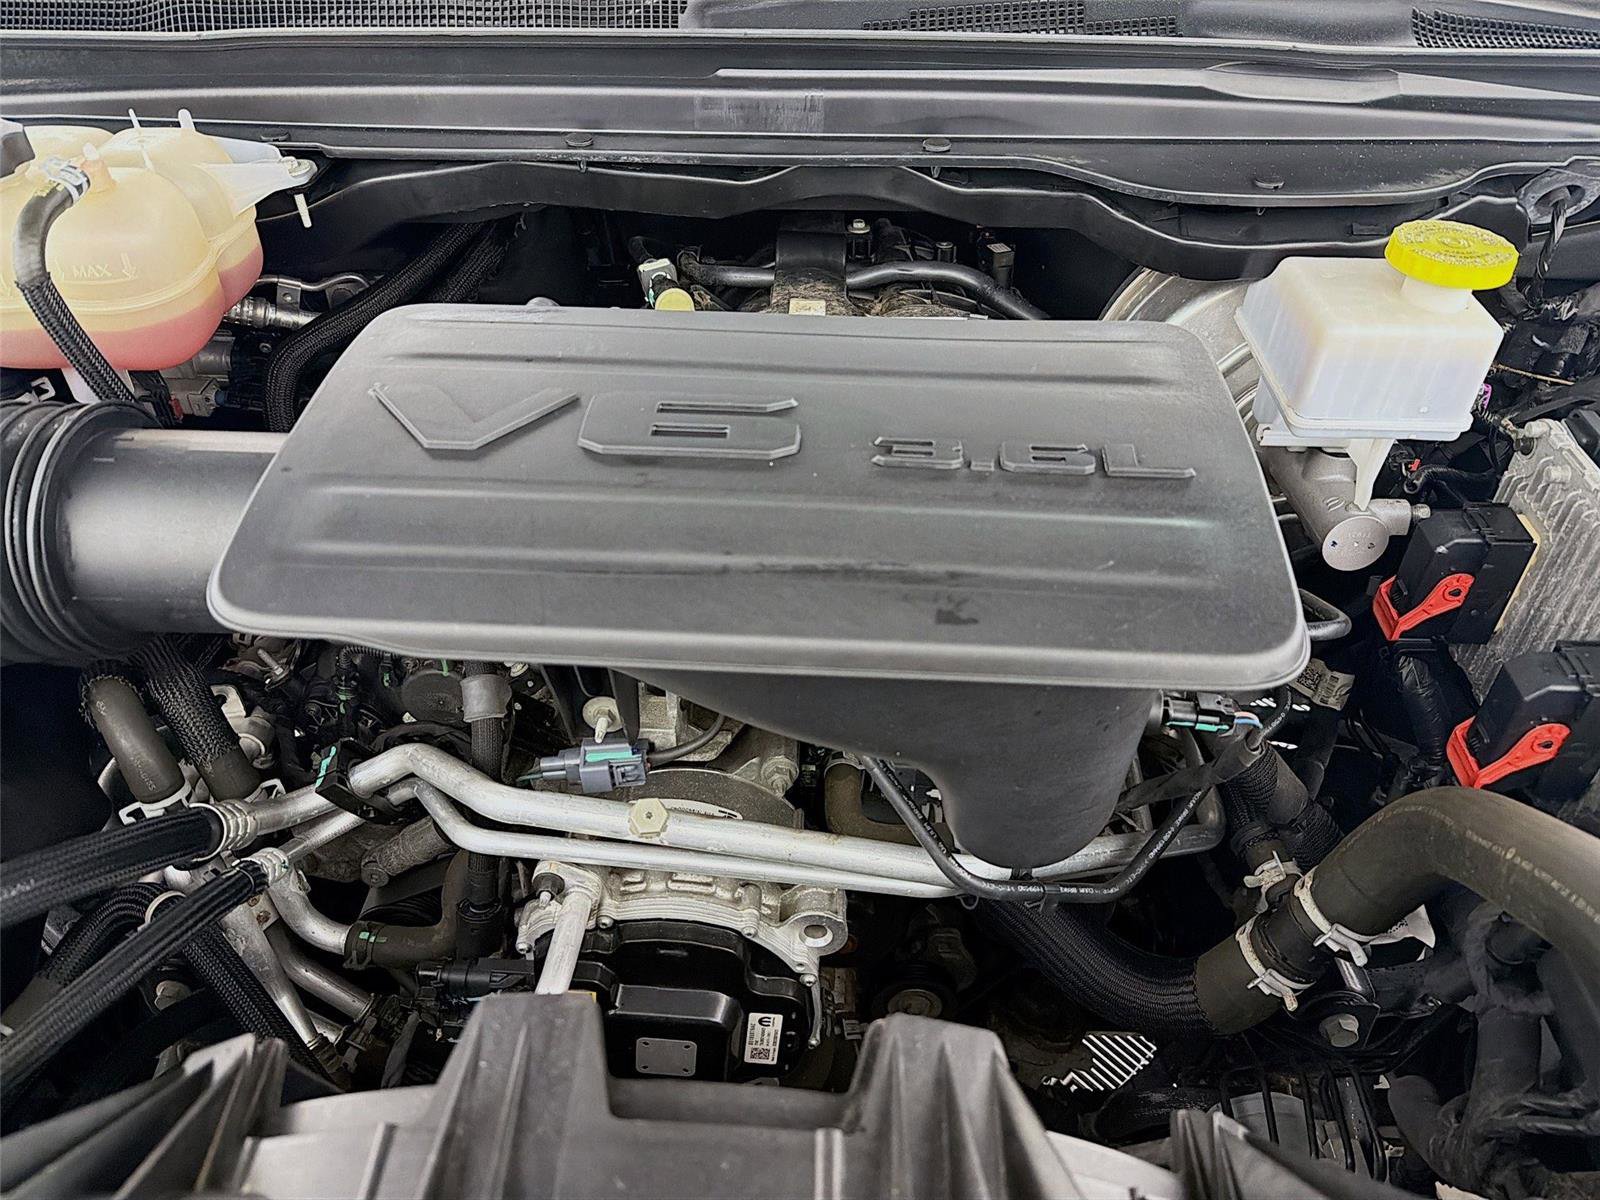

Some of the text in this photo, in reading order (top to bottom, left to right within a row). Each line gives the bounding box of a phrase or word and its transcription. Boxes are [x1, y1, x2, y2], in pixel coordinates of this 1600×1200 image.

[71, 264, 112, 280] MAX
[367, 382, 1197, 478] V6 3.6L
